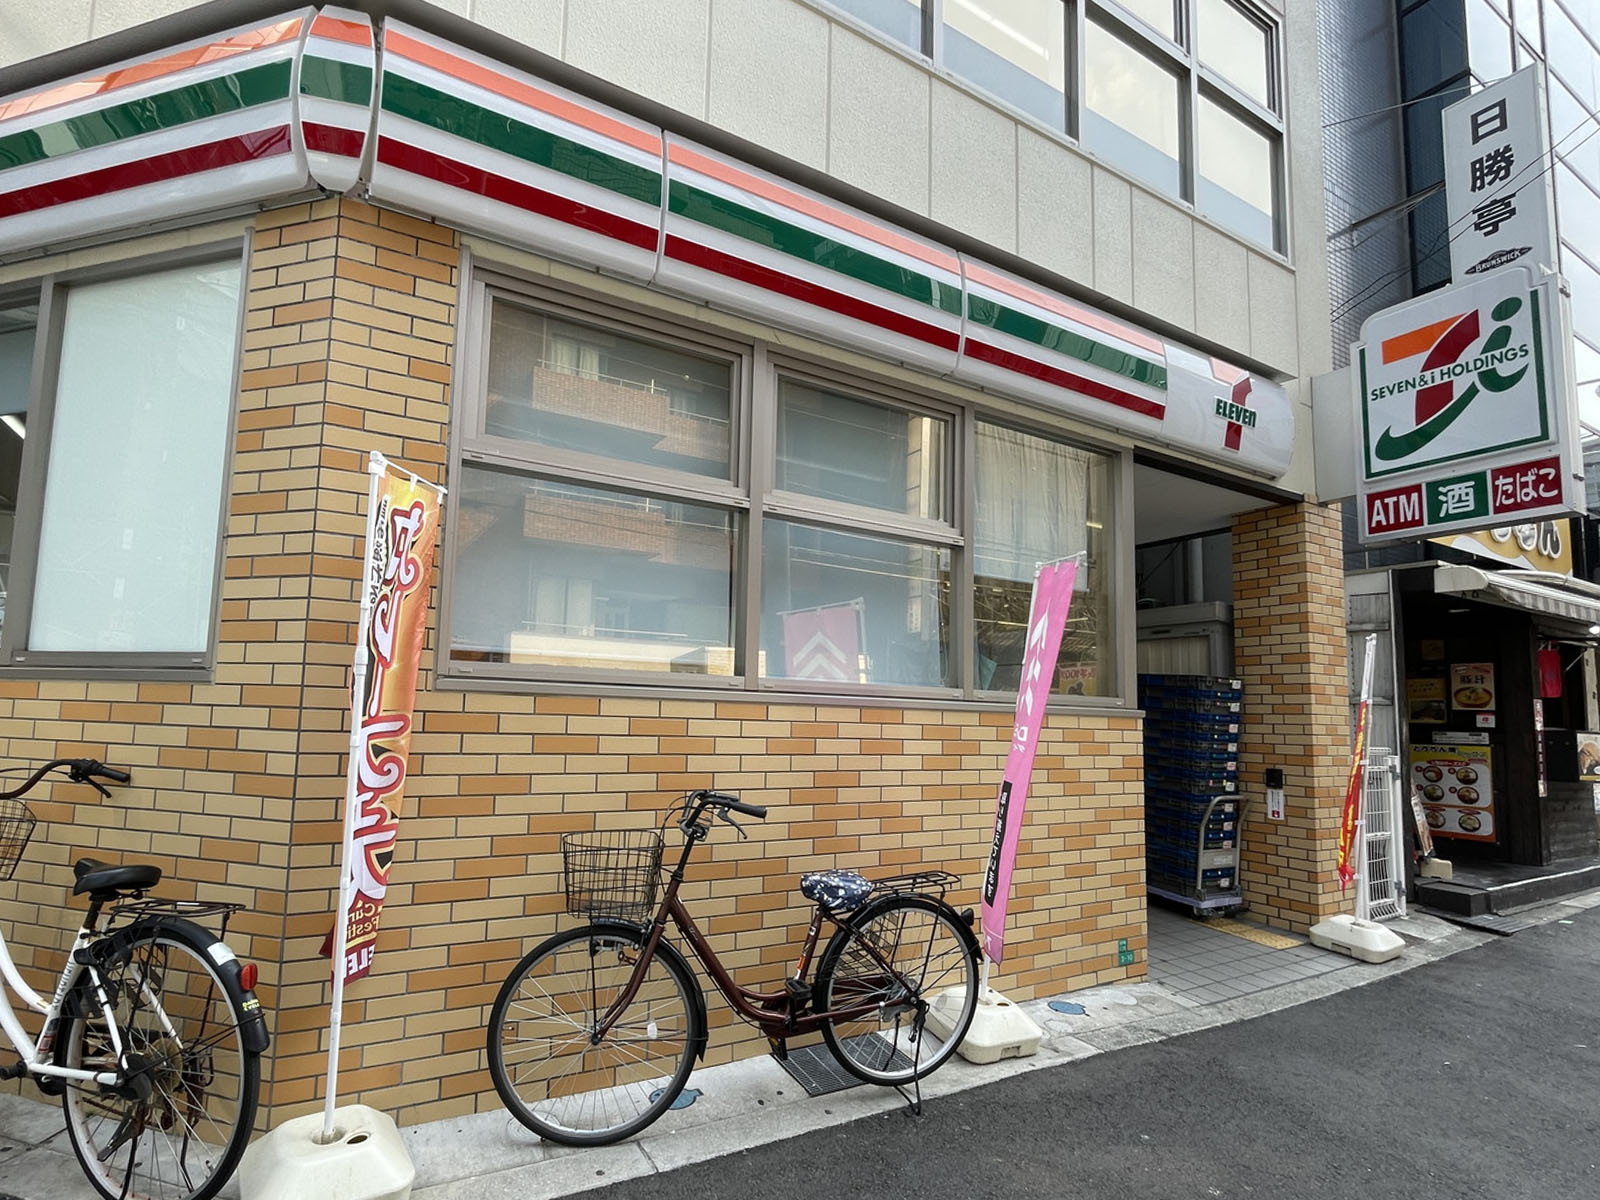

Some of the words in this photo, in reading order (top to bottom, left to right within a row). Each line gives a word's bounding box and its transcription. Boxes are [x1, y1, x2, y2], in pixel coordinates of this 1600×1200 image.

[1470, 98, 1517, 237] 日勝亭
[1440, 343, 1530, 380] HOLDINGS
[1437, 481, 1476, 518] 酒
[1494, 467, 1559, 508] たばこ
[1370, 492, 1420, 528] ATM
